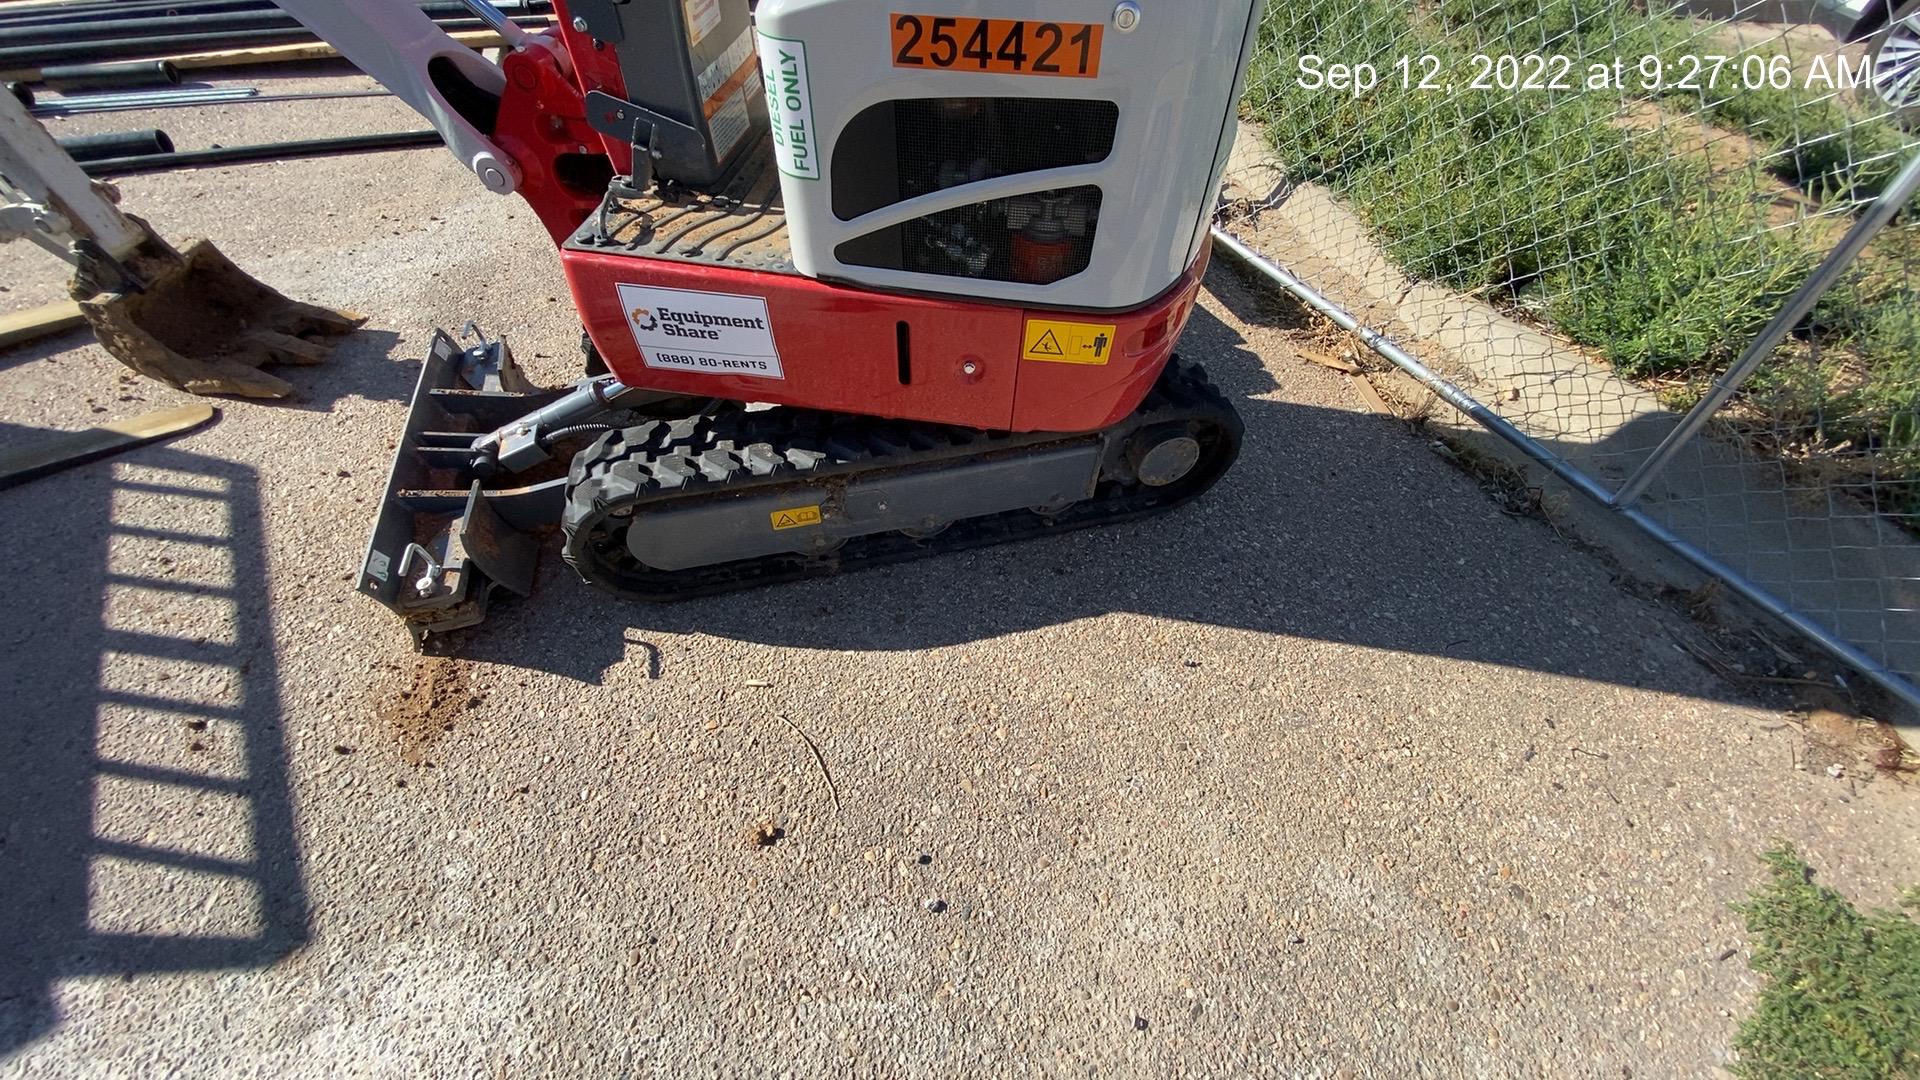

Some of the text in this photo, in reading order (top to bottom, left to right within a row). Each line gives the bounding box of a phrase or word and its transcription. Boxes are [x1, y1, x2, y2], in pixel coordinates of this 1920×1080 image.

[895, 14, 1096, 74] 254421
[766, 69, 784, 147] DIESEL
[779, 49, 810, 171] FUEL ONLY
[656, 307, 765, 330] Equipment
[656, 352, 767, 370] (888) 80-RENTS
